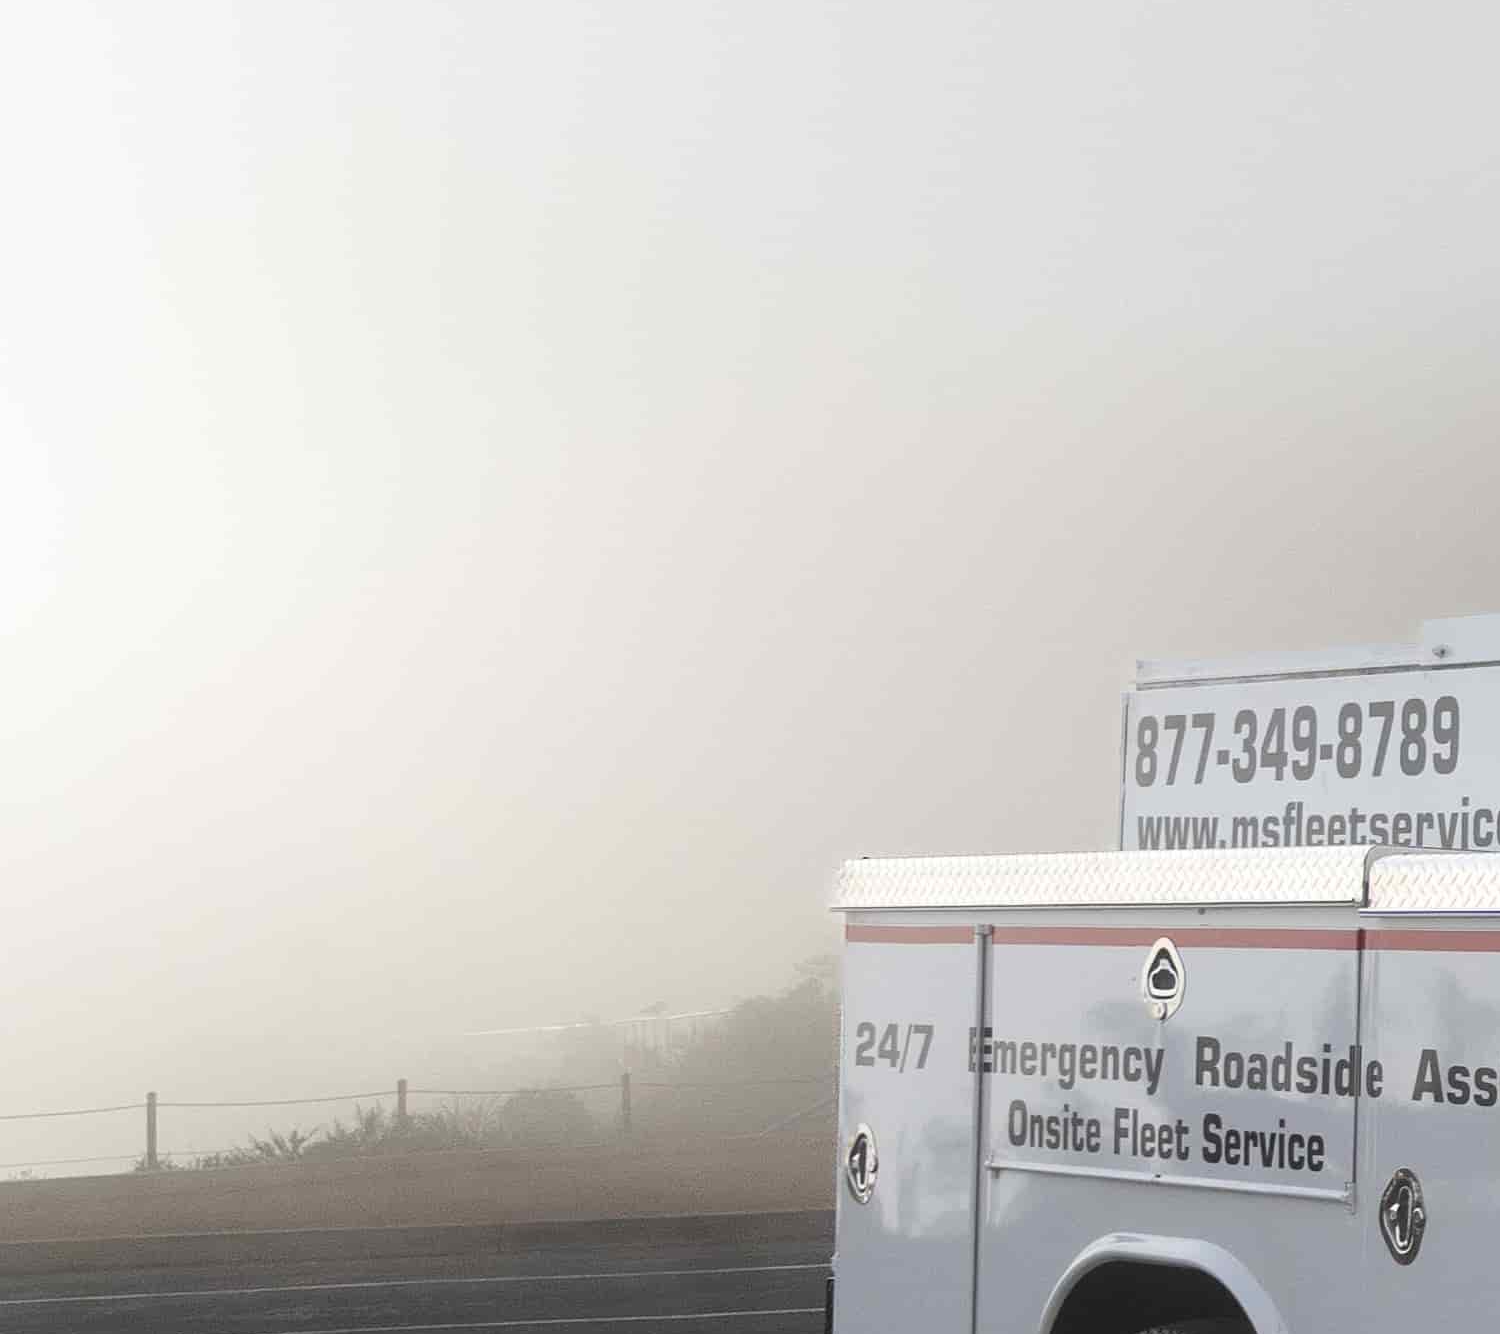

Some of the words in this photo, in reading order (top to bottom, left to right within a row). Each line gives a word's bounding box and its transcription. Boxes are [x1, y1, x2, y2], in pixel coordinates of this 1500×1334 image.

[1135, 695, 1460, 787] 877-349-8789
[855, 1021, 935, 1073] 24/7
[967, 1027, 1165, 1096] Emergency
[1194, 1036, 1383, 1098] Roadside
[1008, 1099, 1101, 1153] Onsite
[1113, 1107, 1190, 1161] Fleet
[1202, 1113, 1325, 1171] Service
